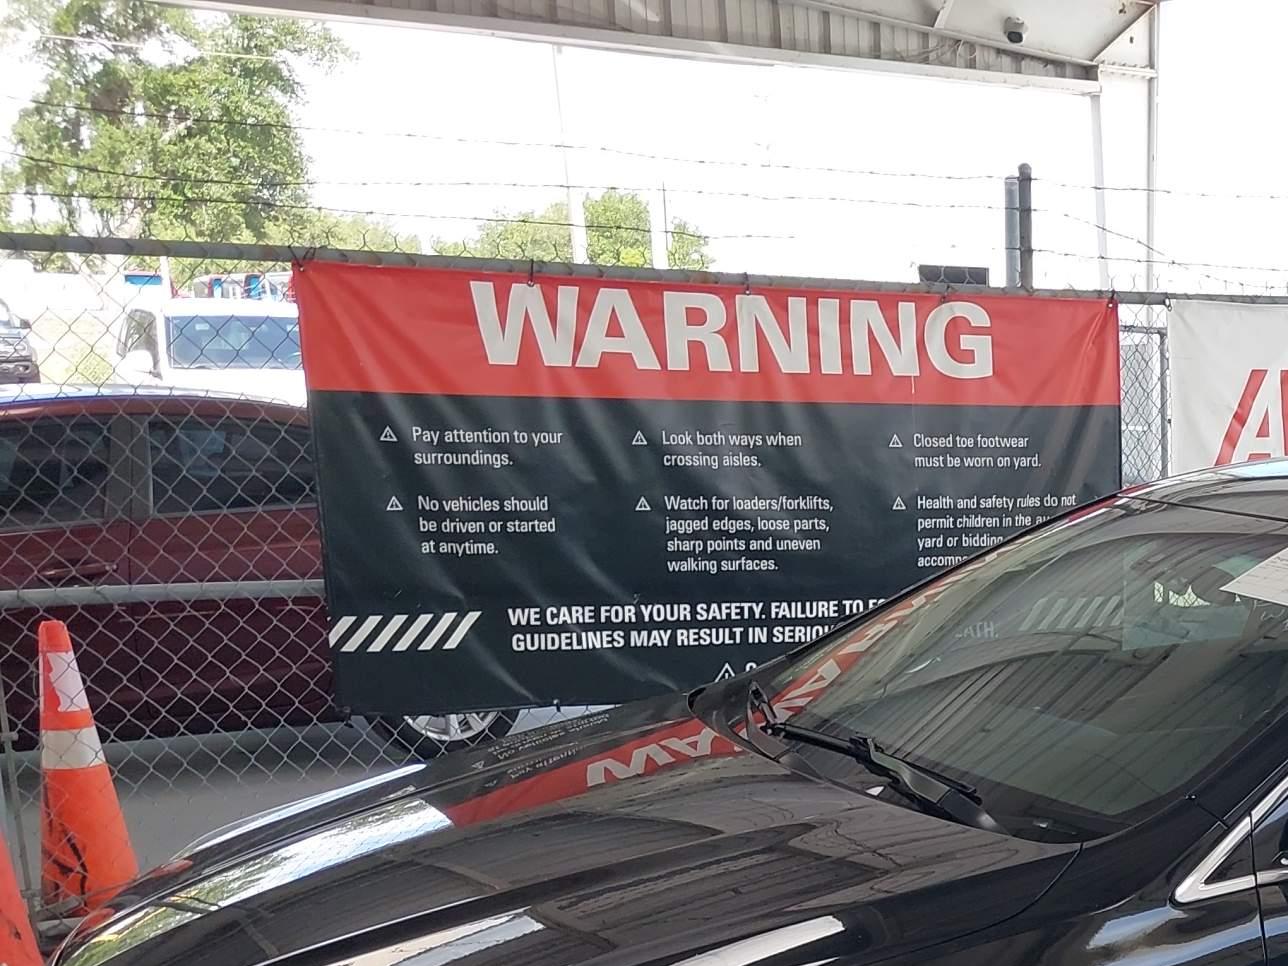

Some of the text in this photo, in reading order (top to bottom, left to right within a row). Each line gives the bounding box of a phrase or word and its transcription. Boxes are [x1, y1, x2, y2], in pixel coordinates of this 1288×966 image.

[469, 280, 993, 379] WARNING
[412, 427, 562, 448] Pay attention to your
[662, 432, 802, 449] Look both ways when
[914, 434, 1028, 448] Closed toe footwear
[414, 450, 513, 467] surroundings.
[663, 453, 761, 469] crossing aisles.
[915, 454, 1041, 470] must be worn on yard.
[418, 496, 548, 512] No vehicles should
[665, 495, 834, 513] Watch for loaders/forklifts,
[917, 494, 1077, 511] Health and safety rules do not
[419, 517, 556, 533] be driven or started
[665, 516, 830, 533] jagged edges, loose parts,
[918, 515, 954, 531] permit
[957, 515, 999, 528] children
[1003, 515, 1012, 527] in
[1015, 514, 1031, 526] the
[421, 539, 498, 556] at anytime.
[667, 536, 820, 553] sharp points and uneven
[917, 535, 943, 551] yard
[947, 536, 959, 548] or
[667, 557, 778, 574] walking surfaces.
[508, 608, 541, 626] WE
[545, 606, 595, 625] CARE
[600, 606, 636, 624] FOR
[640, 604, 691, 622] YOUR
[696, 603, 766, 621] SAFETY.
[770, 601, 839, 619] FAILURE
[842, 600, 864, 616] TO
[512, 632, 625, 651] GUIDELINES
[630, 629, 671, 648] MAY
[677, 627, 744, 646] RESULT
[748, 627, 767, 644] IN
